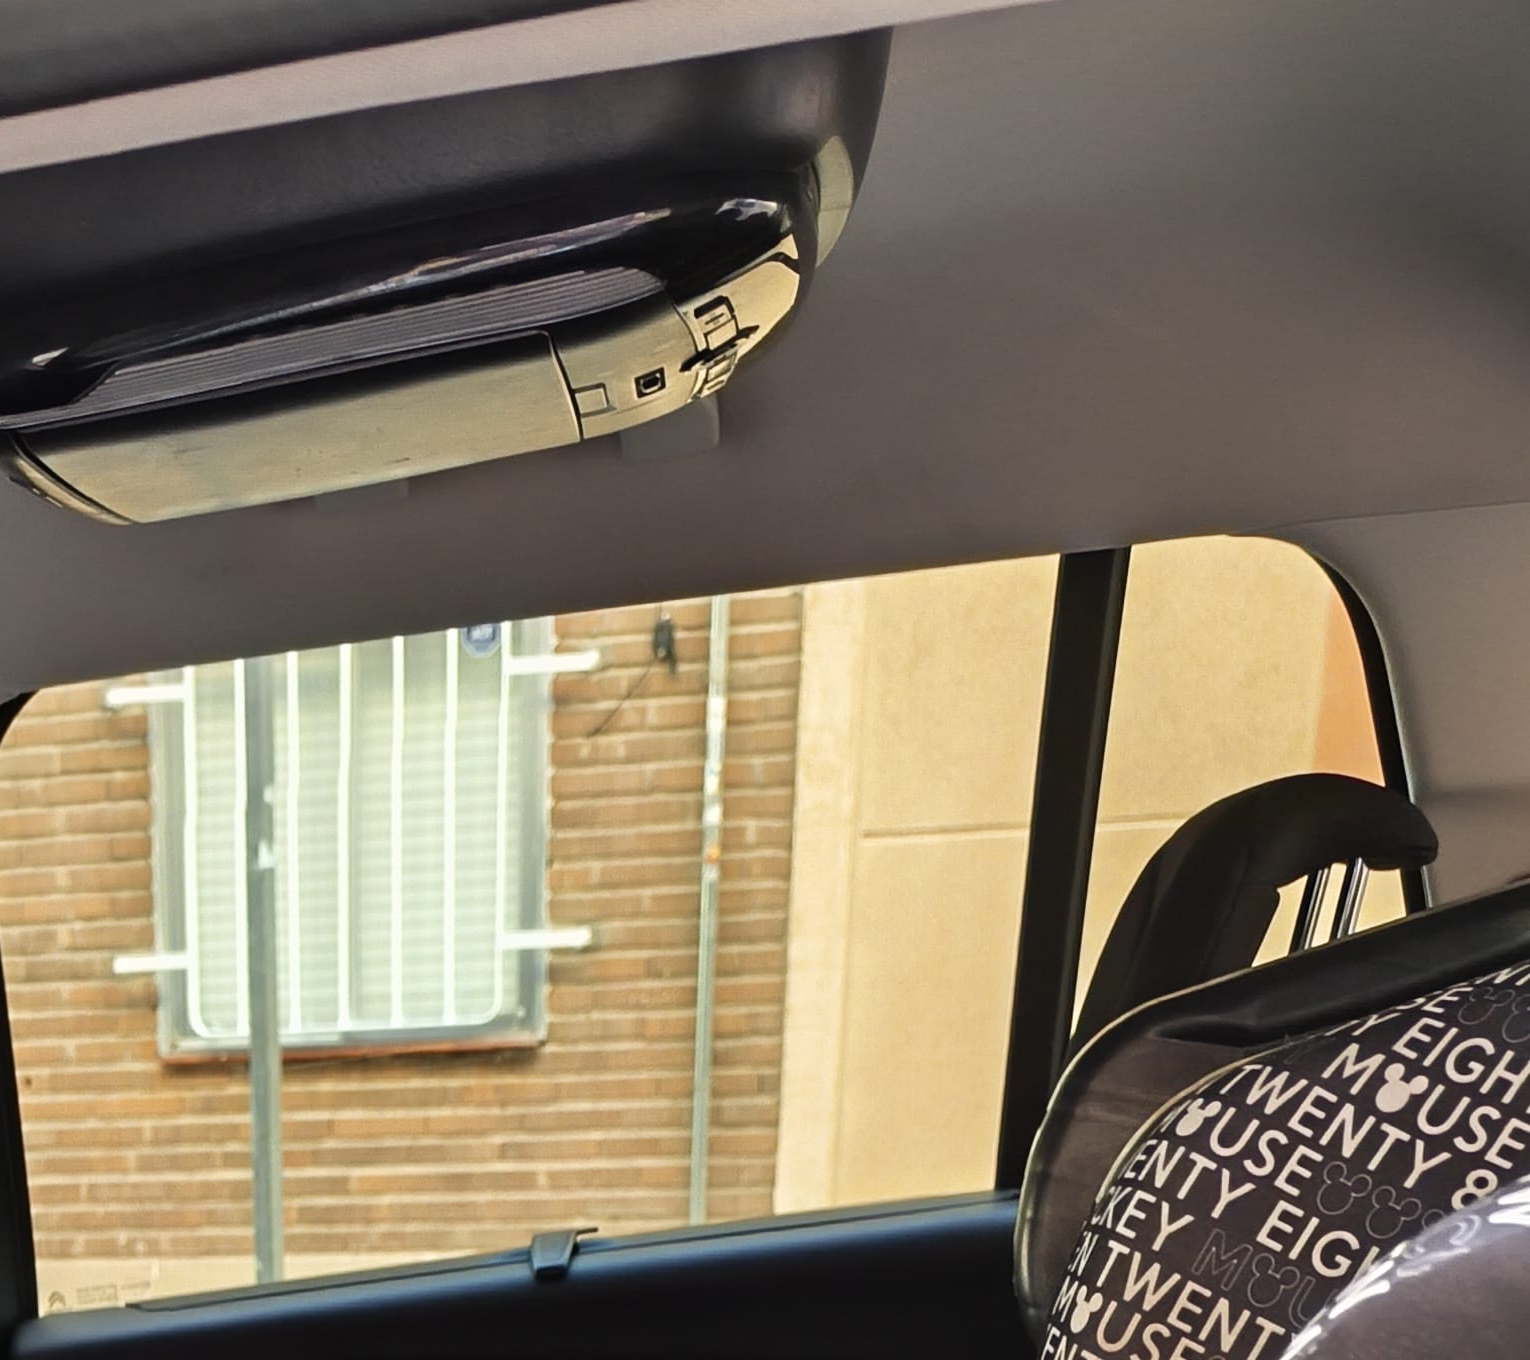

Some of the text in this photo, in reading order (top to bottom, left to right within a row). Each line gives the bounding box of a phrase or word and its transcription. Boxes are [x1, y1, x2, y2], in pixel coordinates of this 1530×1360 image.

[1391, 1017, 1530, 1114] EIGH
[1220, 1064, 1452, 1189] TWENTY
[1119, 1138, 1257, 1218] ENTY
